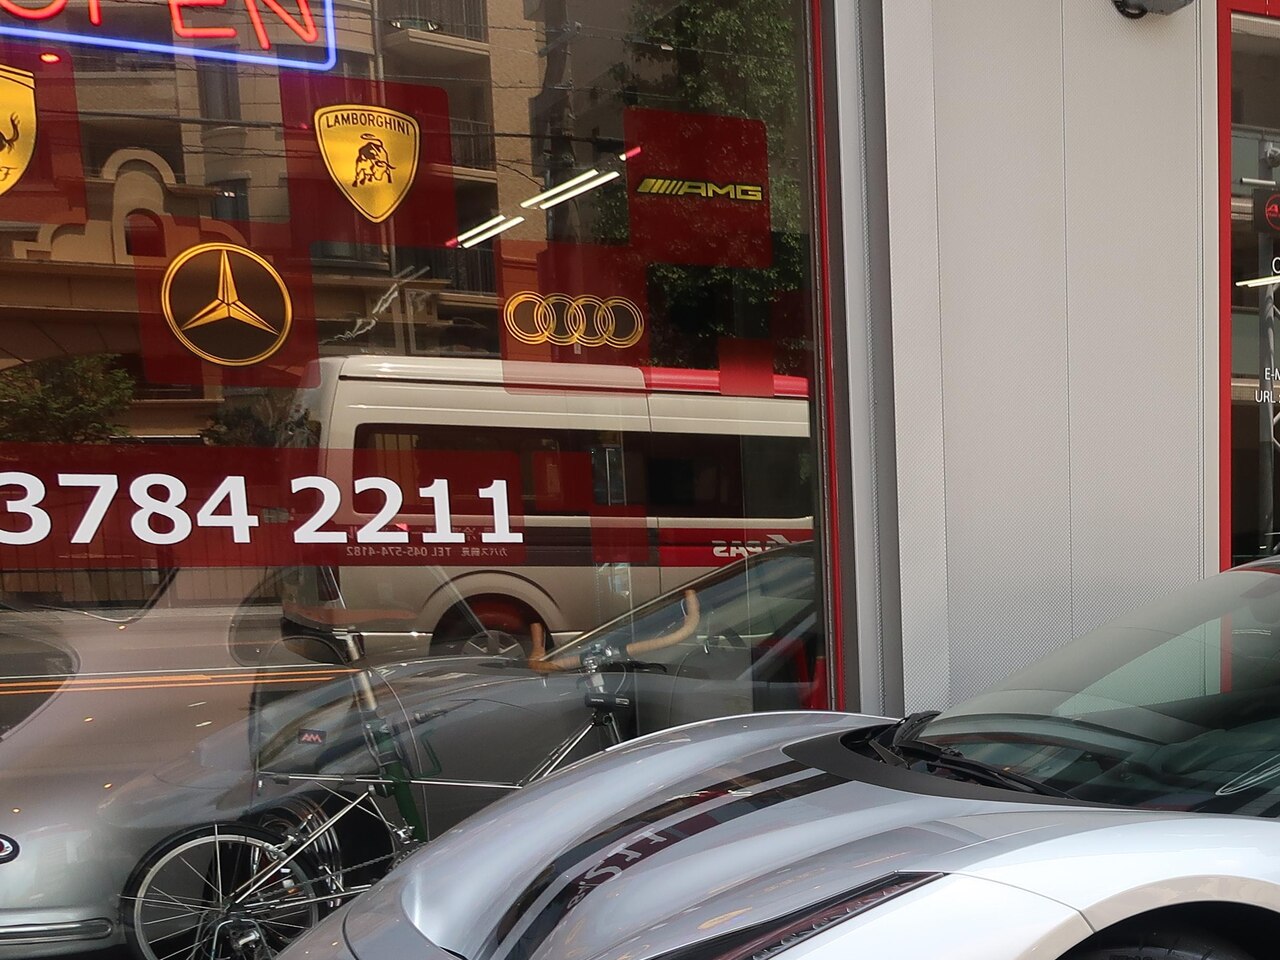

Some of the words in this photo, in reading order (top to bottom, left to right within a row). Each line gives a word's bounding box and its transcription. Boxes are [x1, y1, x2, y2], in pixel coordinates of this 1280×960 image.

[325, 112, 410, 136] LAMBORGHINI
[678, 181, 762, 200] AMG
[1255, 390, 1276, 403] URL
[0, 471, 259, 544] 3784
[290, 475, 524, 544] 2211
